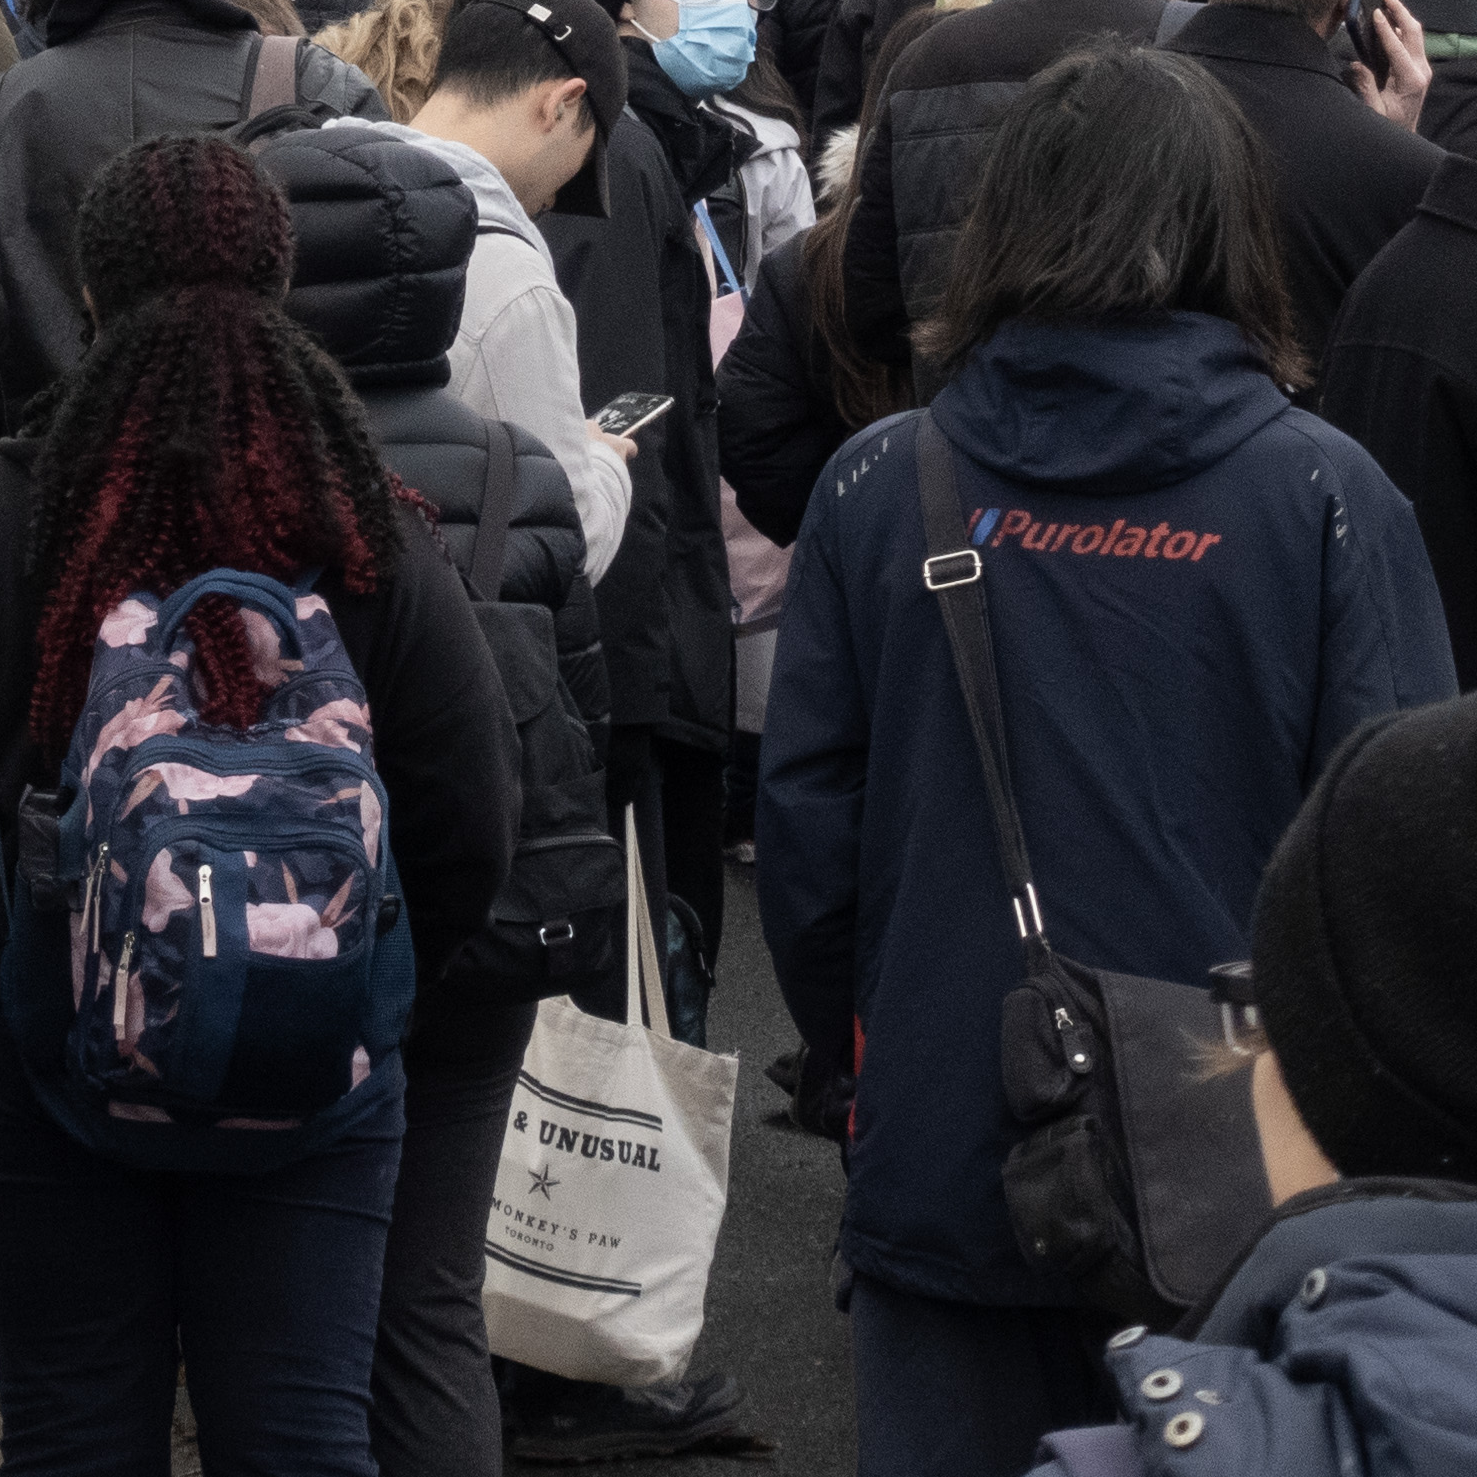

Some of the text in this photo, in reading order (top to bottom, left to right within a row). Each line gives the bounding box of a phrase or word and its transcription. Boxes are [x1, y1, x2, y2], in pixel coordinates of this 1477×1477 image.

[990, 508, 1222, 563] Purolator
[513, 1110, 661, 1173] & UNUSUAL
[490, 1196, 622, 1250] MONKEY'S PAW
[504, 1225, 555, 1252] TORONTO
